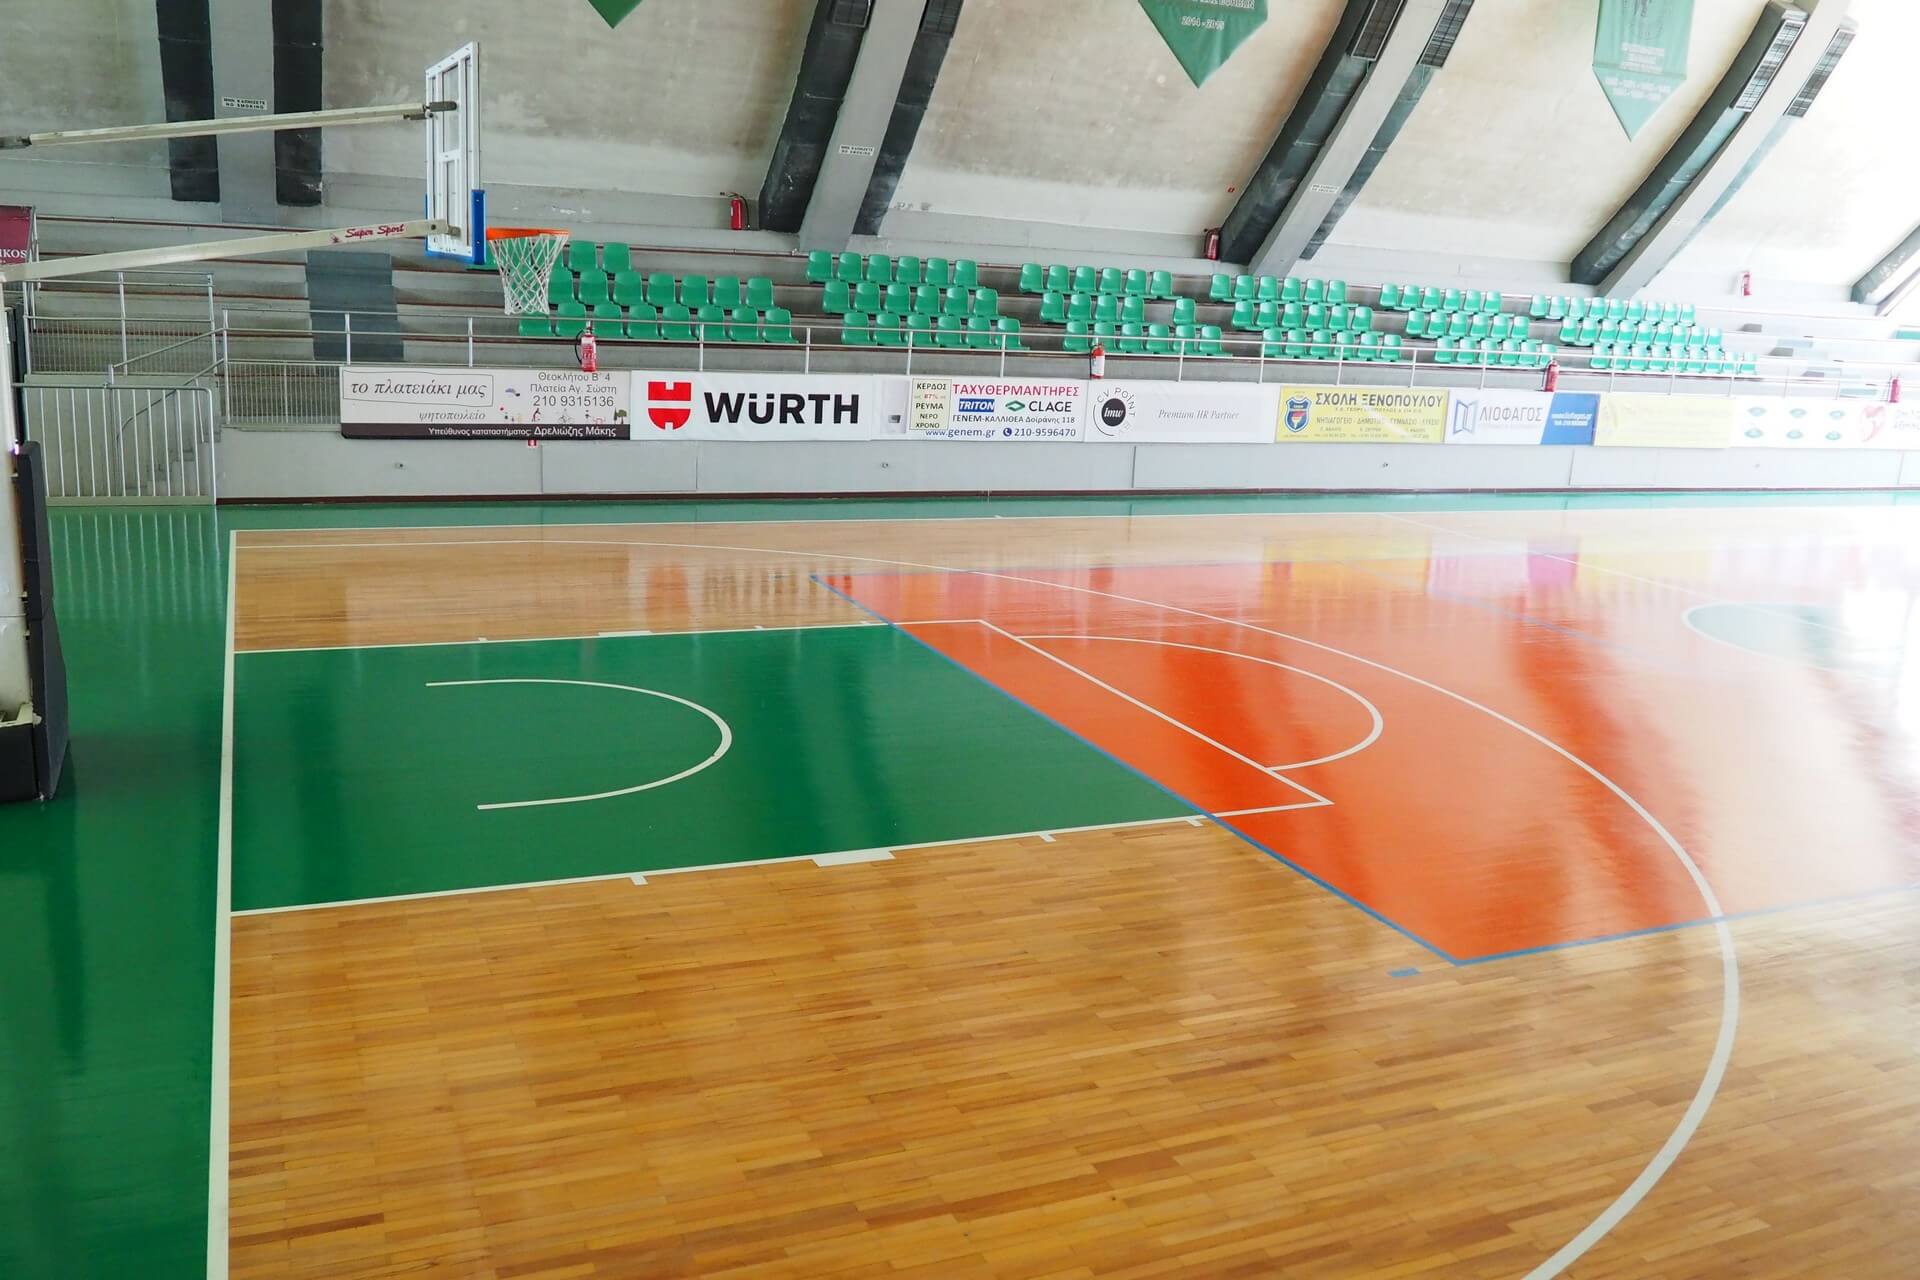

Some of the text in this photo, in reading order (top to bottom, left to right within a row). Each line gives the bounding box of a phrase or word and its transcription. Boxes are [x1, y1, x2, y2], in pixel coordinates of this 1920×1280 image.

[345, 224, 405, 239] Super Sport
[604, 373, 611, 381] 4
[351, 378, 487, 399] το πλατειάκι μας
[530, 384, 566, 393] Πλατεία
[569, 384, 583, 394] Αγ.
[917, 382, 947, 391] ΚΕΡΔΟΣ
[952, 383, 1079, 397] ΤΑΧΥΘΕΡΜΑΝΤΗΡΕΣ
[533, 395, 614, 407] 210 9315136
[915, 402, 944, 410] ΡΕΥΜΑ
[1315, 393, 1443, 408] ΣΧΟΛΗ ΞΕΝΟΠΟΥΛΟΥ
[960, 401, 1072, 412] TRITON CLAGE
[419, 409, 486, 422] ψητοπωλείο
[1158, 409, 1240, 420] Premium HR Partner
[1480, 406, 1543, 422] ΛΙΟΦΑΓΟΣ
[1062, 416, 1075, 424] 118
[428, 427, 470, 436] Υπεύθυνος
[585, 426, 617, 437] Μάκης
[925, 428, 1077, 438] www.genem.gr 210-9596470
